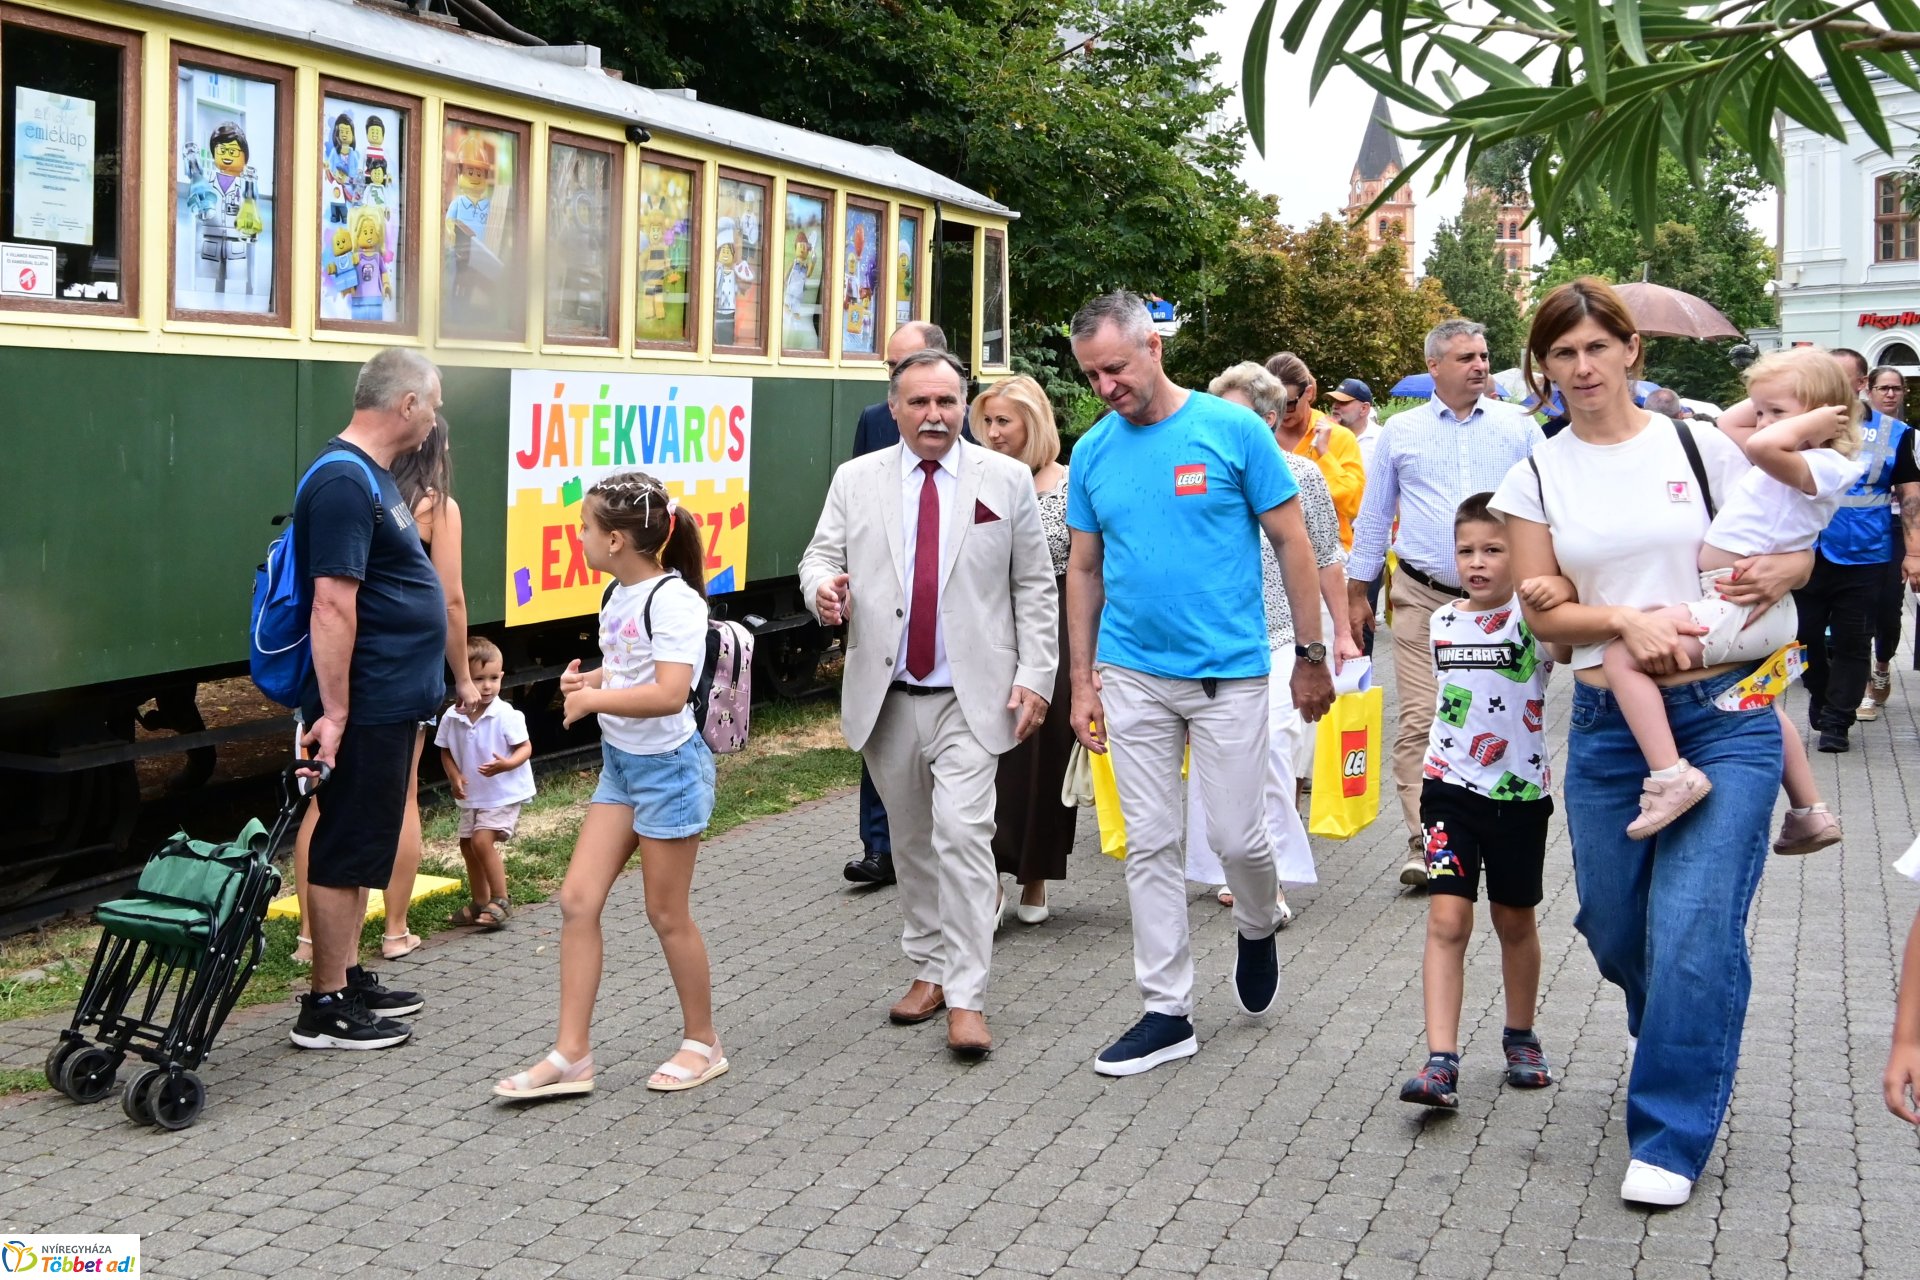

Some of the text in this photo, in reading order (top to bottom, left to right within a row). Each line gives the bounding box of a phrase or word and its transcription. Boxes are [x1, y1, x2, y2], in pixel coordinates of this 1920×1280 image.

[25, 124, 87, 152] emléklap
[1858, 313, 1898, 329] Pizza
[516, 383, 746, 469] JÁTÉKVÁROS
[1177, 472, 1204, 486] LEGO
[1437, 648, 1511, 662] MINECRAFT
